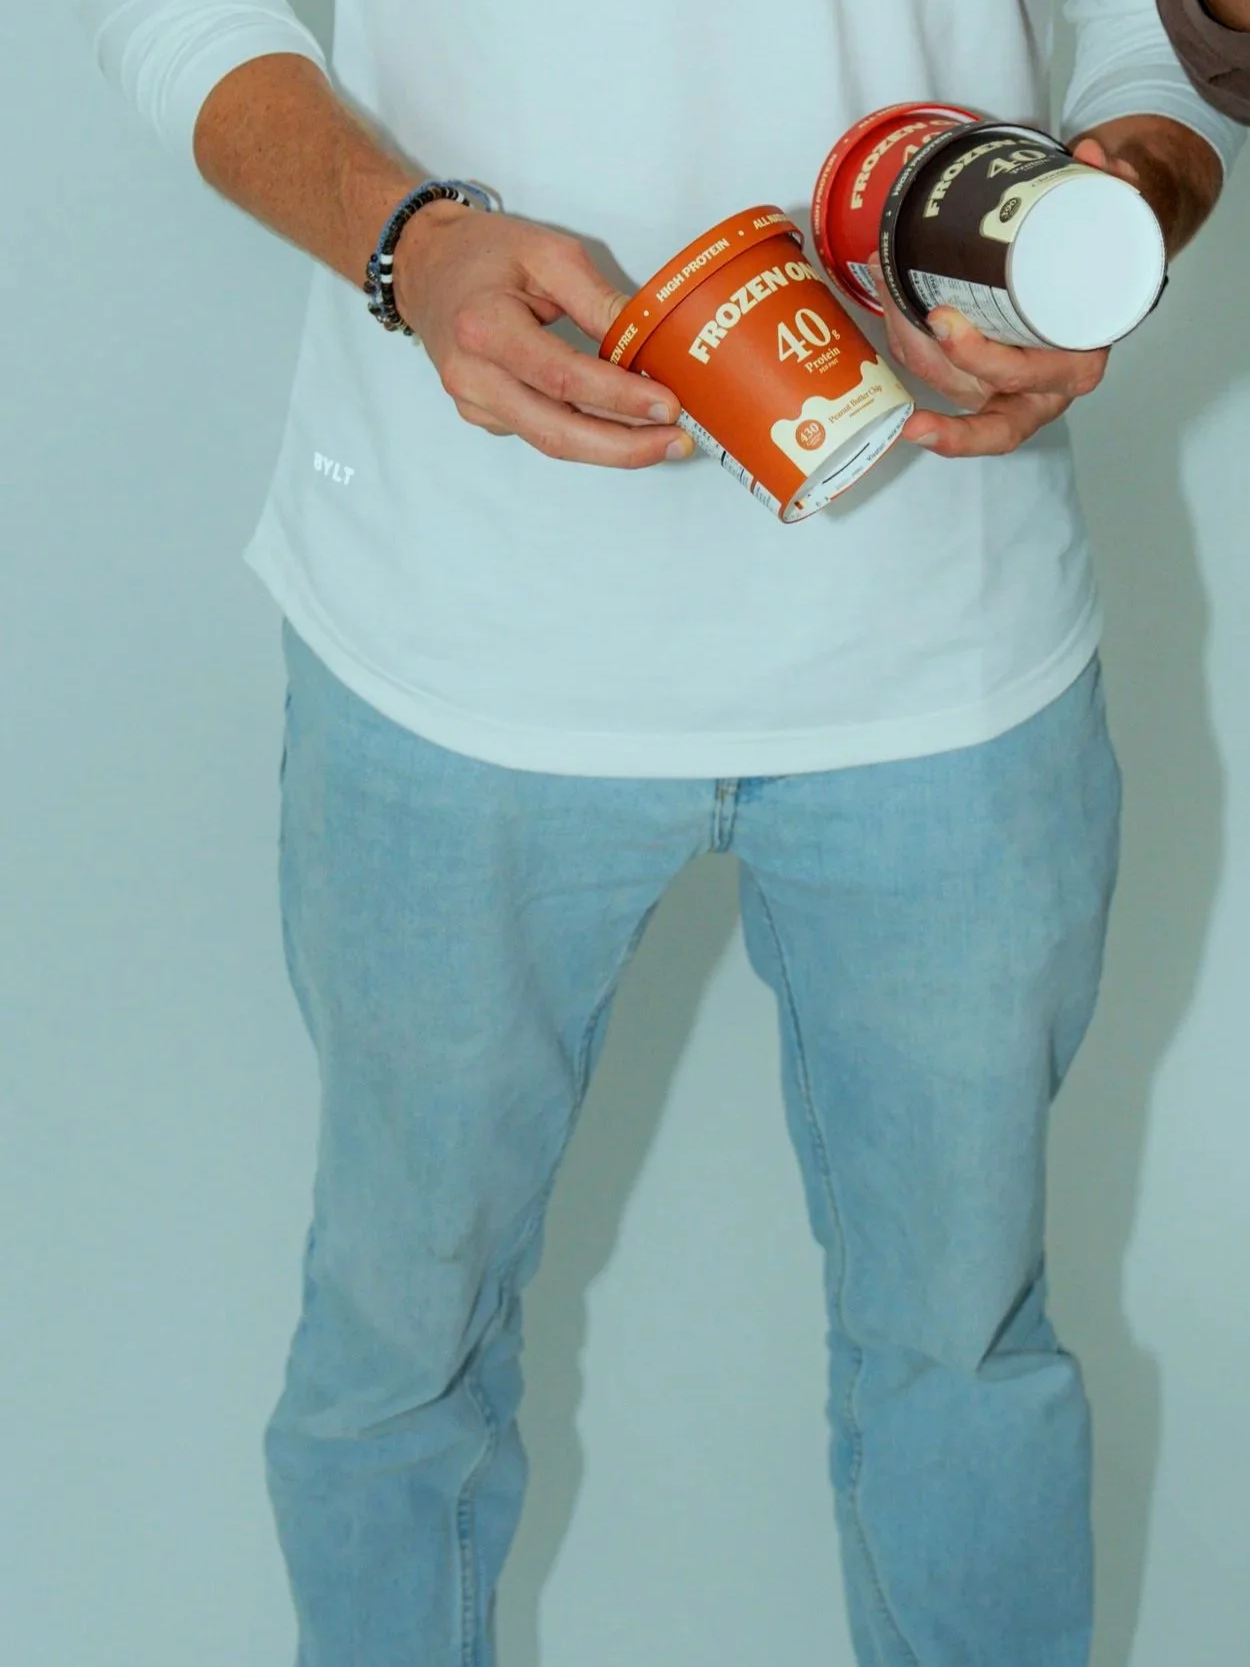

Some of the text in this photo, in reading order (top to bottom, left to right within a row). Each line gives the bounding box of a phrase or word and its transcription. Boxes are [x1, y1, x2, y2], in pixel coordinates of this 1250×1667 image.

[851, 121, 928, 210] FROZEN
[923, 139, 1016, 219] FROZEN
[619, 323, 639, 351] FREE
[655, 273, 685, 303] HIGH
[682, 238, 730, 278] PROTEIN
[752, 216, 770, 231] ALL
[688, 266, 789, 365] FROZEN
[784, 261, 820, 281] ON
[804, 346, 841, 374] Protein
[800, 423, 820, 444] 430
[828, 405, 852, 424] Peanut
[850, 391, 870, 407] Butter
[868, 384, 883, 396] Chip
